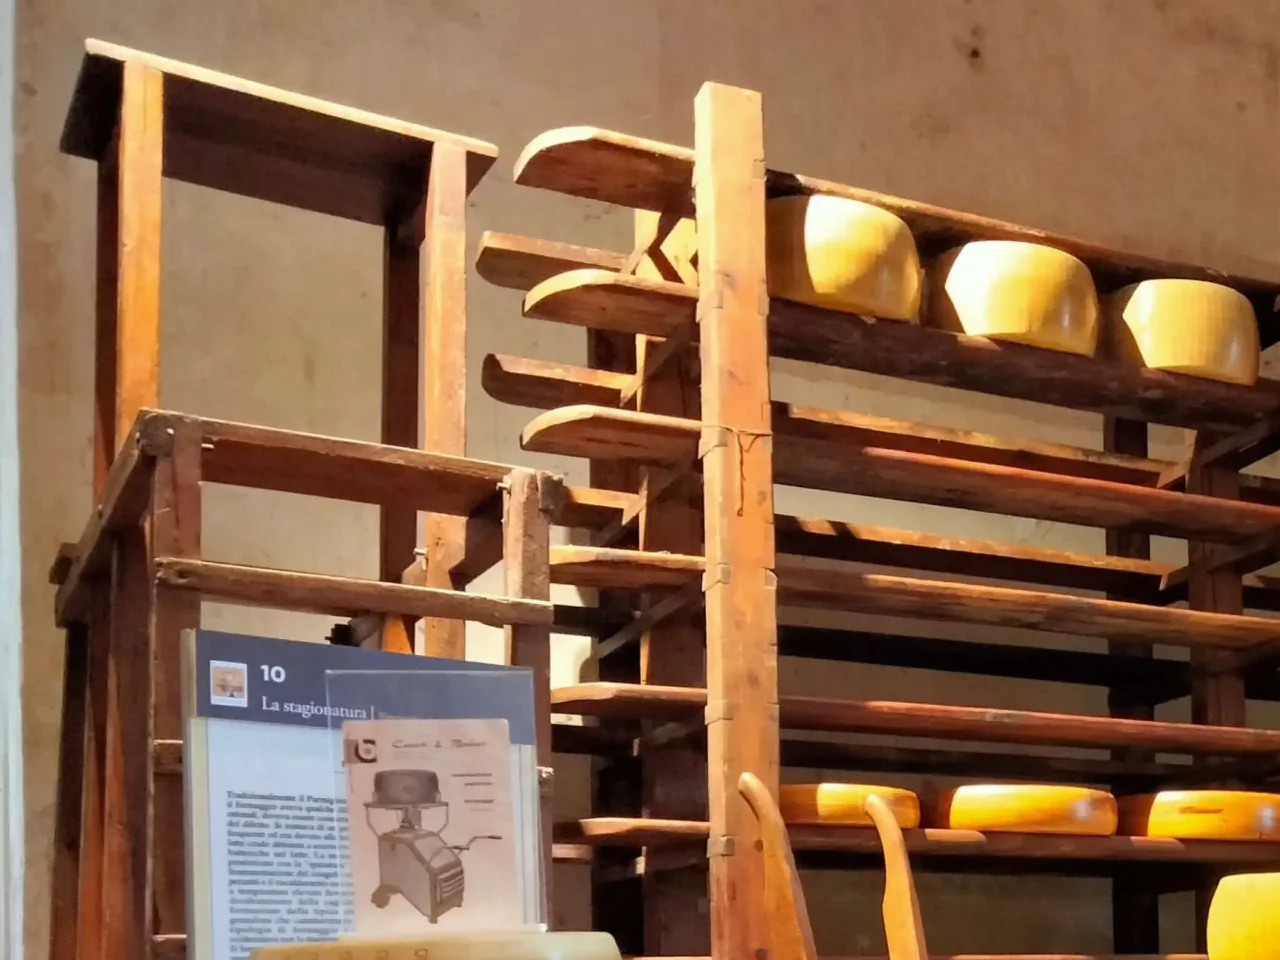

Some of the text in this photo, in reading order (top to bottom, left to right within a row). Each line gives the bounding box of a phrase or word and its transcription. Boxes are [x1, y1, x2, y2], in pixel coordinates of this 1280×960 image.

[260, 664, 286, 683] 10
[262, 696, 367, 718] La stagionatura
